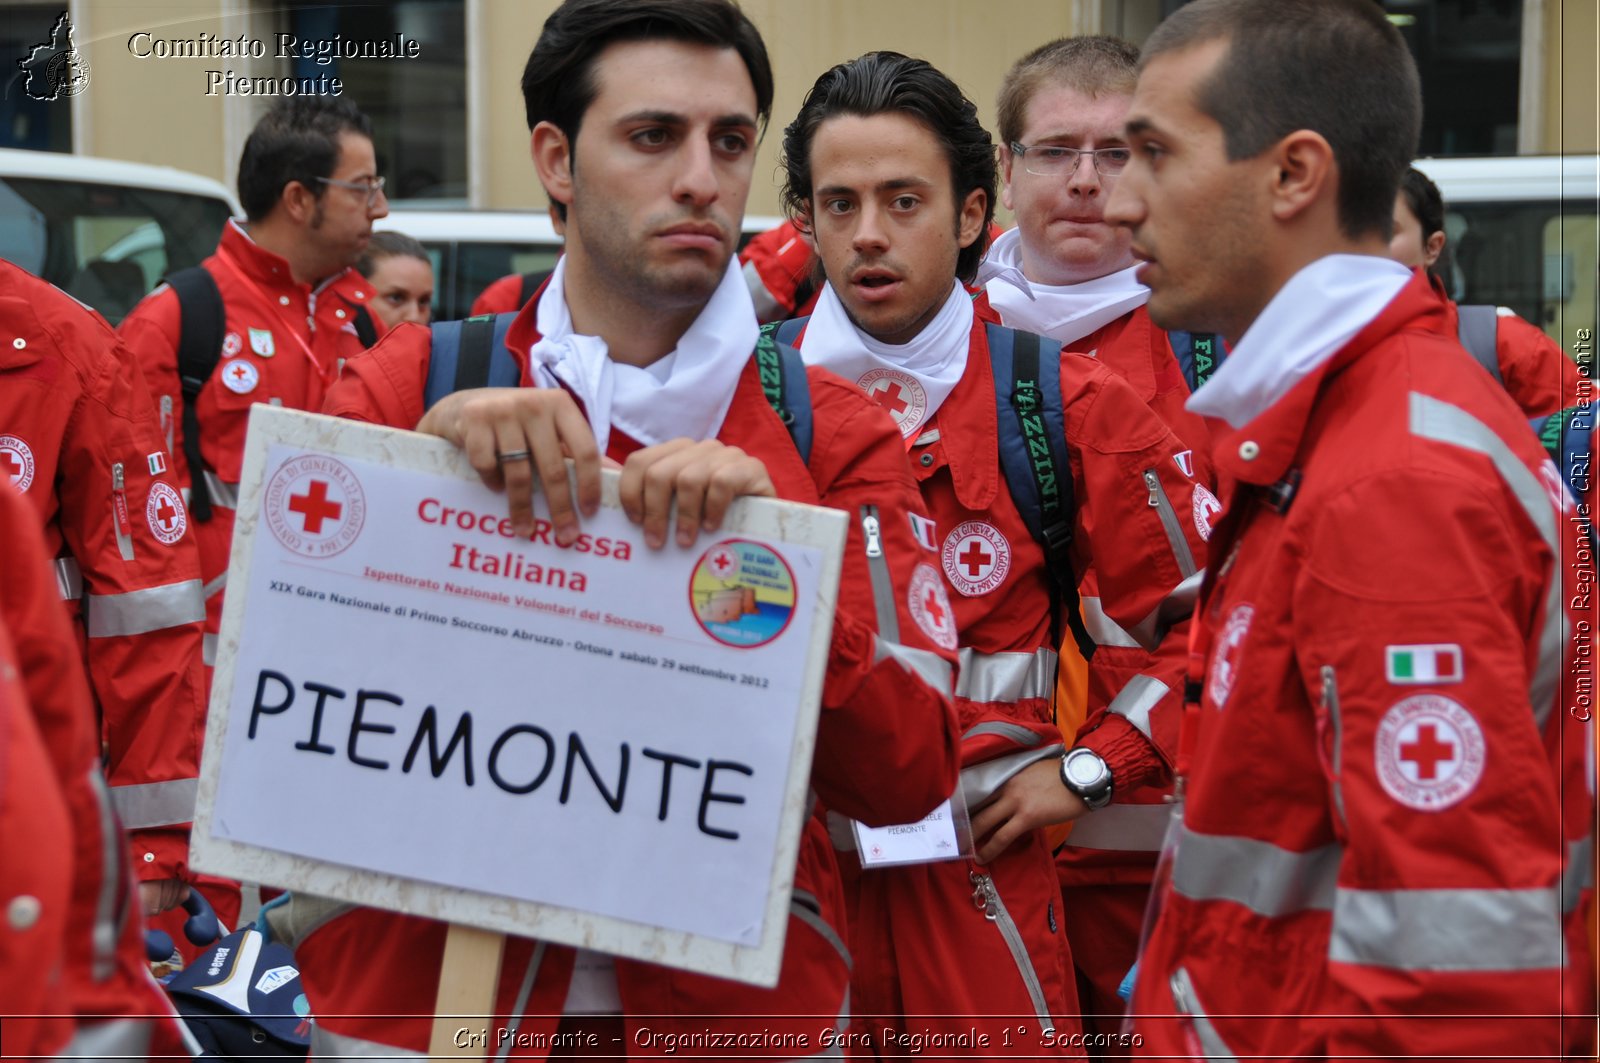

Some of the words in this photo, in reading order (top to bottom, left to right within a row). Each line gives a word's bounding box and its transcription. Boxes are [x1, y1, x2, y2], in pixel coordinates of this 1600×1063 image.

[301, 460, 347, 483] GINEVRA
[341, 498, 360, 540] AGOSTO
[417, 497, 515, 539] Croce
[952, 529, 962, 542] DI
[961, 523, 996, 540] GINEVRA
[993, 538, 1005, 550] 22
[449, 543, 587, 592] Italiana
[944, 540, 970, 592] CONVENZIONE
[977, 579, 994, 593] 1864
[991, 550, 1008, 582] AGOSTO
[363, 566, 441, 593] Ispettorato
[444, 581, 511, 605] Nazionale
[514, 594, 577, 618] Volontari
[579, 609, 601, 625] del
[604, 613, 665, 636] Soccorso
[269, 580, 293, 594] XIX
[297, 586, 326, 602] Gara
[330, 593, 392, 615] Nazionale
[394, 606, 408, 618] di
[410, 608, 448, 626] Primo
[451, 616, 509, 638] Soccorso
[511, 628, 564, 648] Abruzzo
[574, 641, 615, 658] Ortona
[620, 650, 659, 667] sabato
[661, 657, 677, 670] 29
[678, 662, 737, 683] settembre
[739, 673, 770, 689] 2012
[248, 667, 755, 841] PIEMONTE
[887, 824, 927, 836] PIEMONTE
